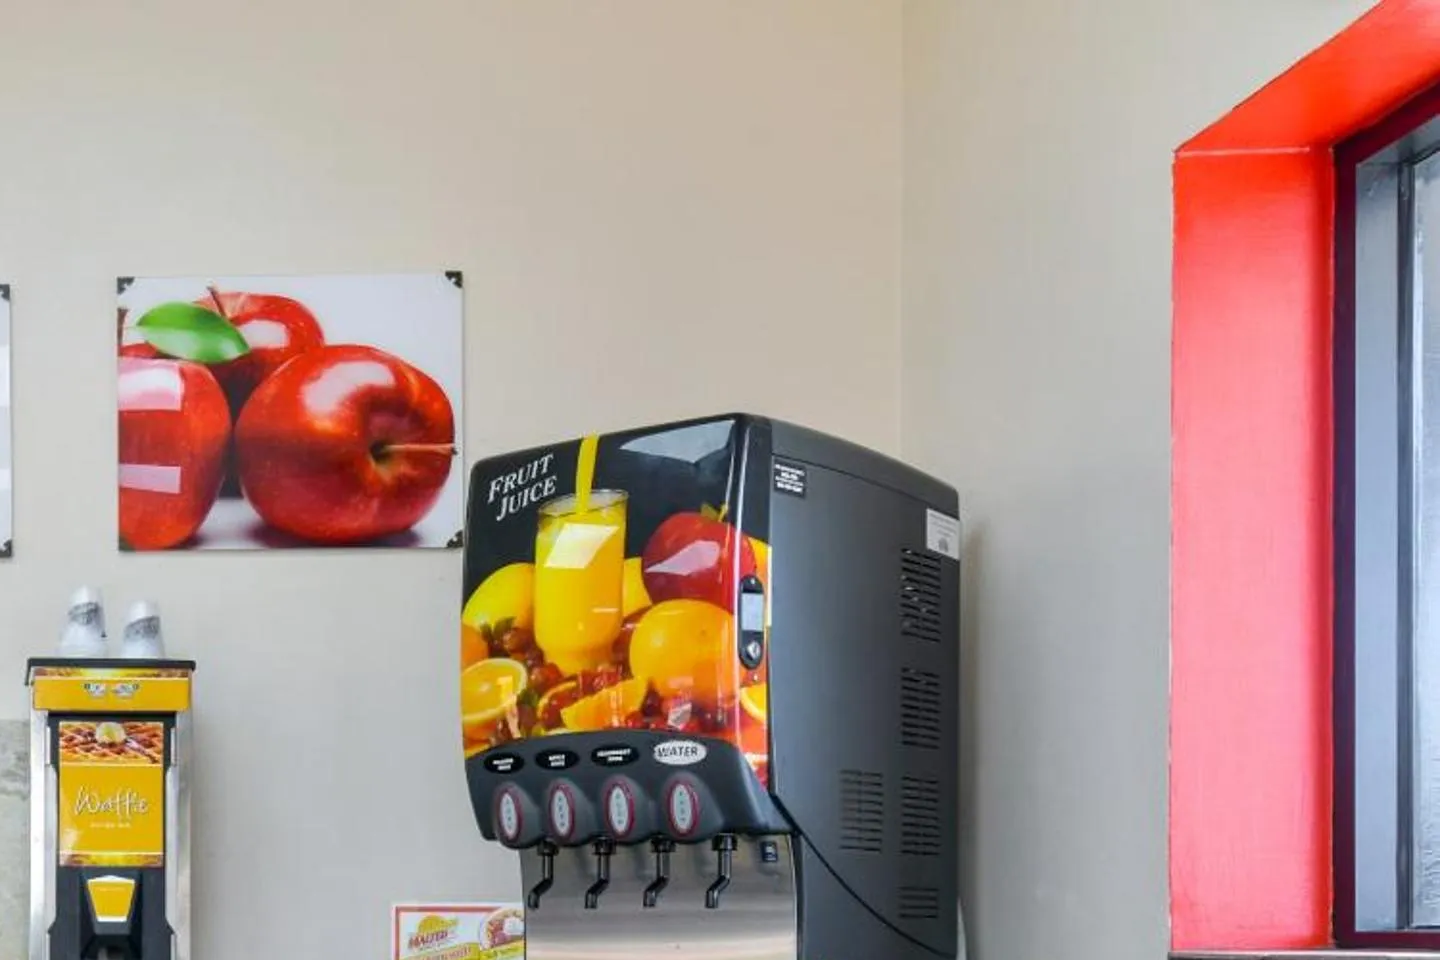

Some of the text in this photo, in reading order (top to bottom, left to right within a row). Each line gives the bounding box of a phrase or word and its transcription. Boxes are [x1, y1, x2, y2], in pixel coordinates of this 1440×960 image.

[488, 453, 554, 504] FRUIT
[496, 475, 557, 521] JUICE
[657, 746, 699, 757] WATER
[74, 784, 149, 819] Waffle
